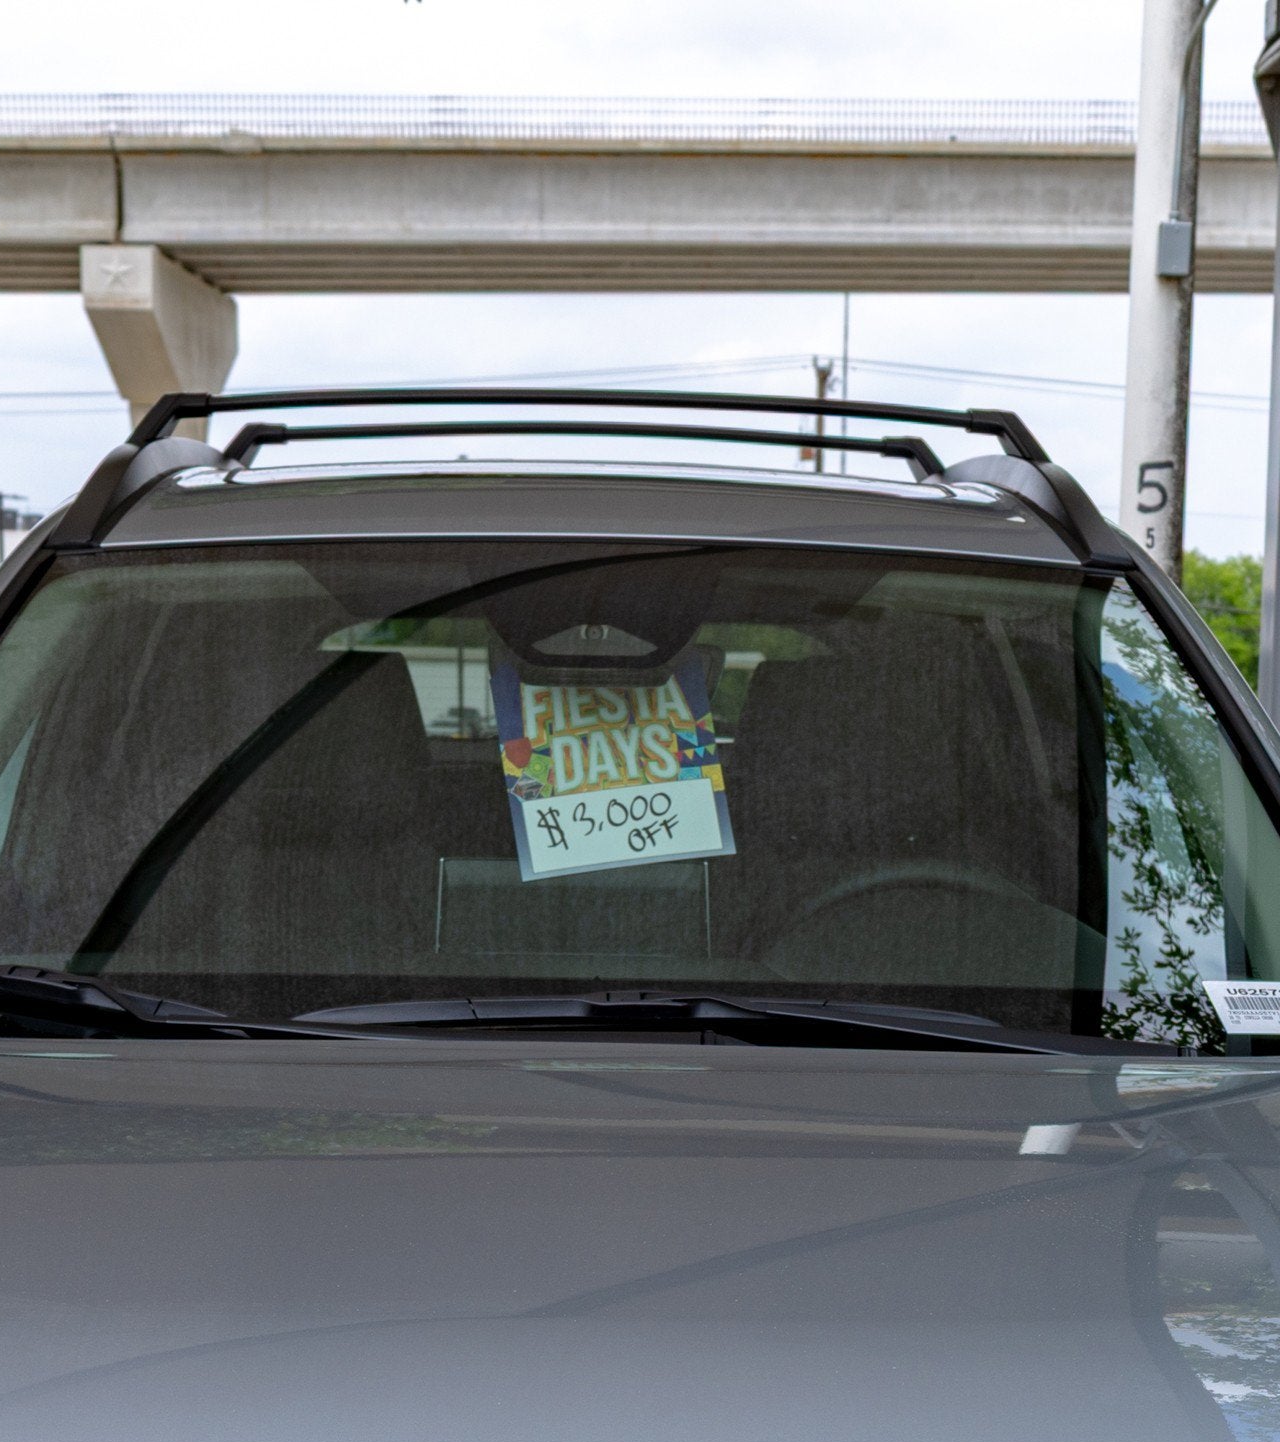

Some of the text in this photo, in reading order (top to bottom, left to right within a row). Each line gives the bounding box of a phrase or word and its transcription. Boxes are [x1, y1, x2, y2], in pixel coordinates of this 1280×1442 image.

[1137, 460, 1174, 513] 5
[1146, 527, 1155, 549] 5
[551, 723, 680, 793] DAYS
[627, 813, 680, 852] OFF
